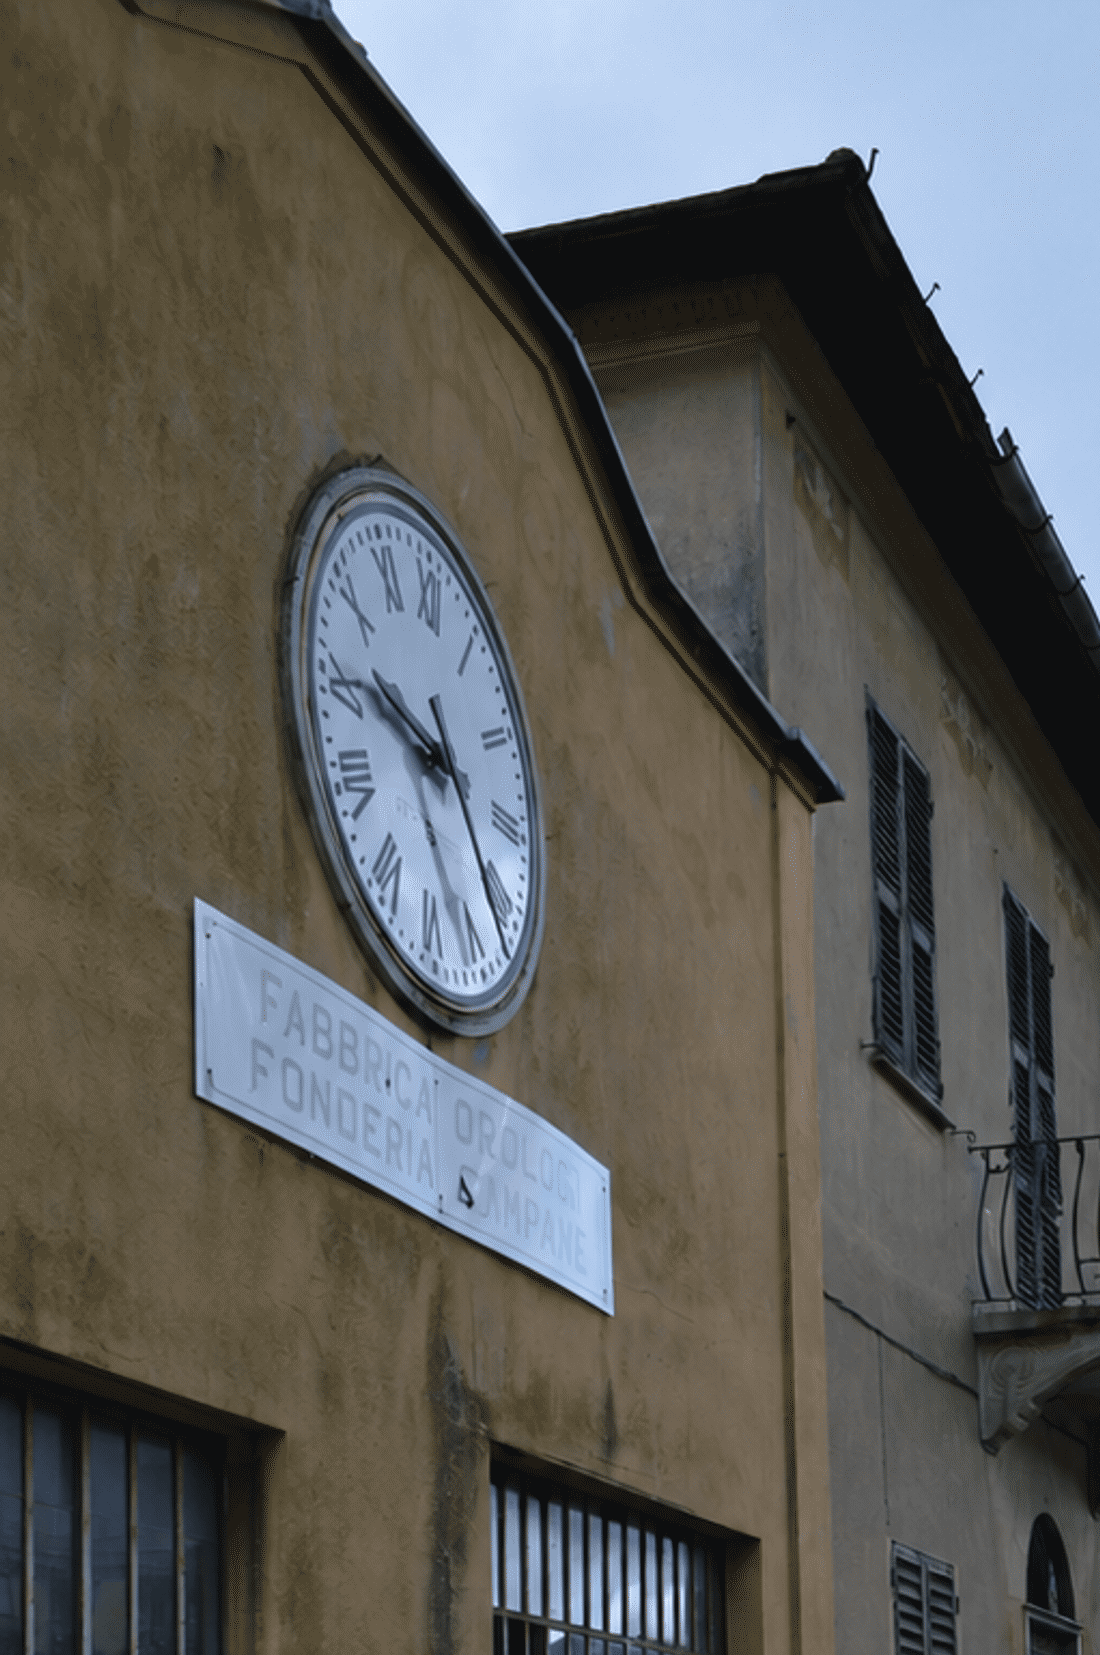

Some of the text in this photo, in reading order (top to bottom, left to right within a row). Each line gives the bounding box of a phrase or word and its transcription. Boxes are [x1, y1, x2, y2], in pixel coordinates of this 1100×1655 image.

[248, 1036, 435, 1190] FONDERIA
[259, 967, 581, 1214] FABBRICA OROLOGI
